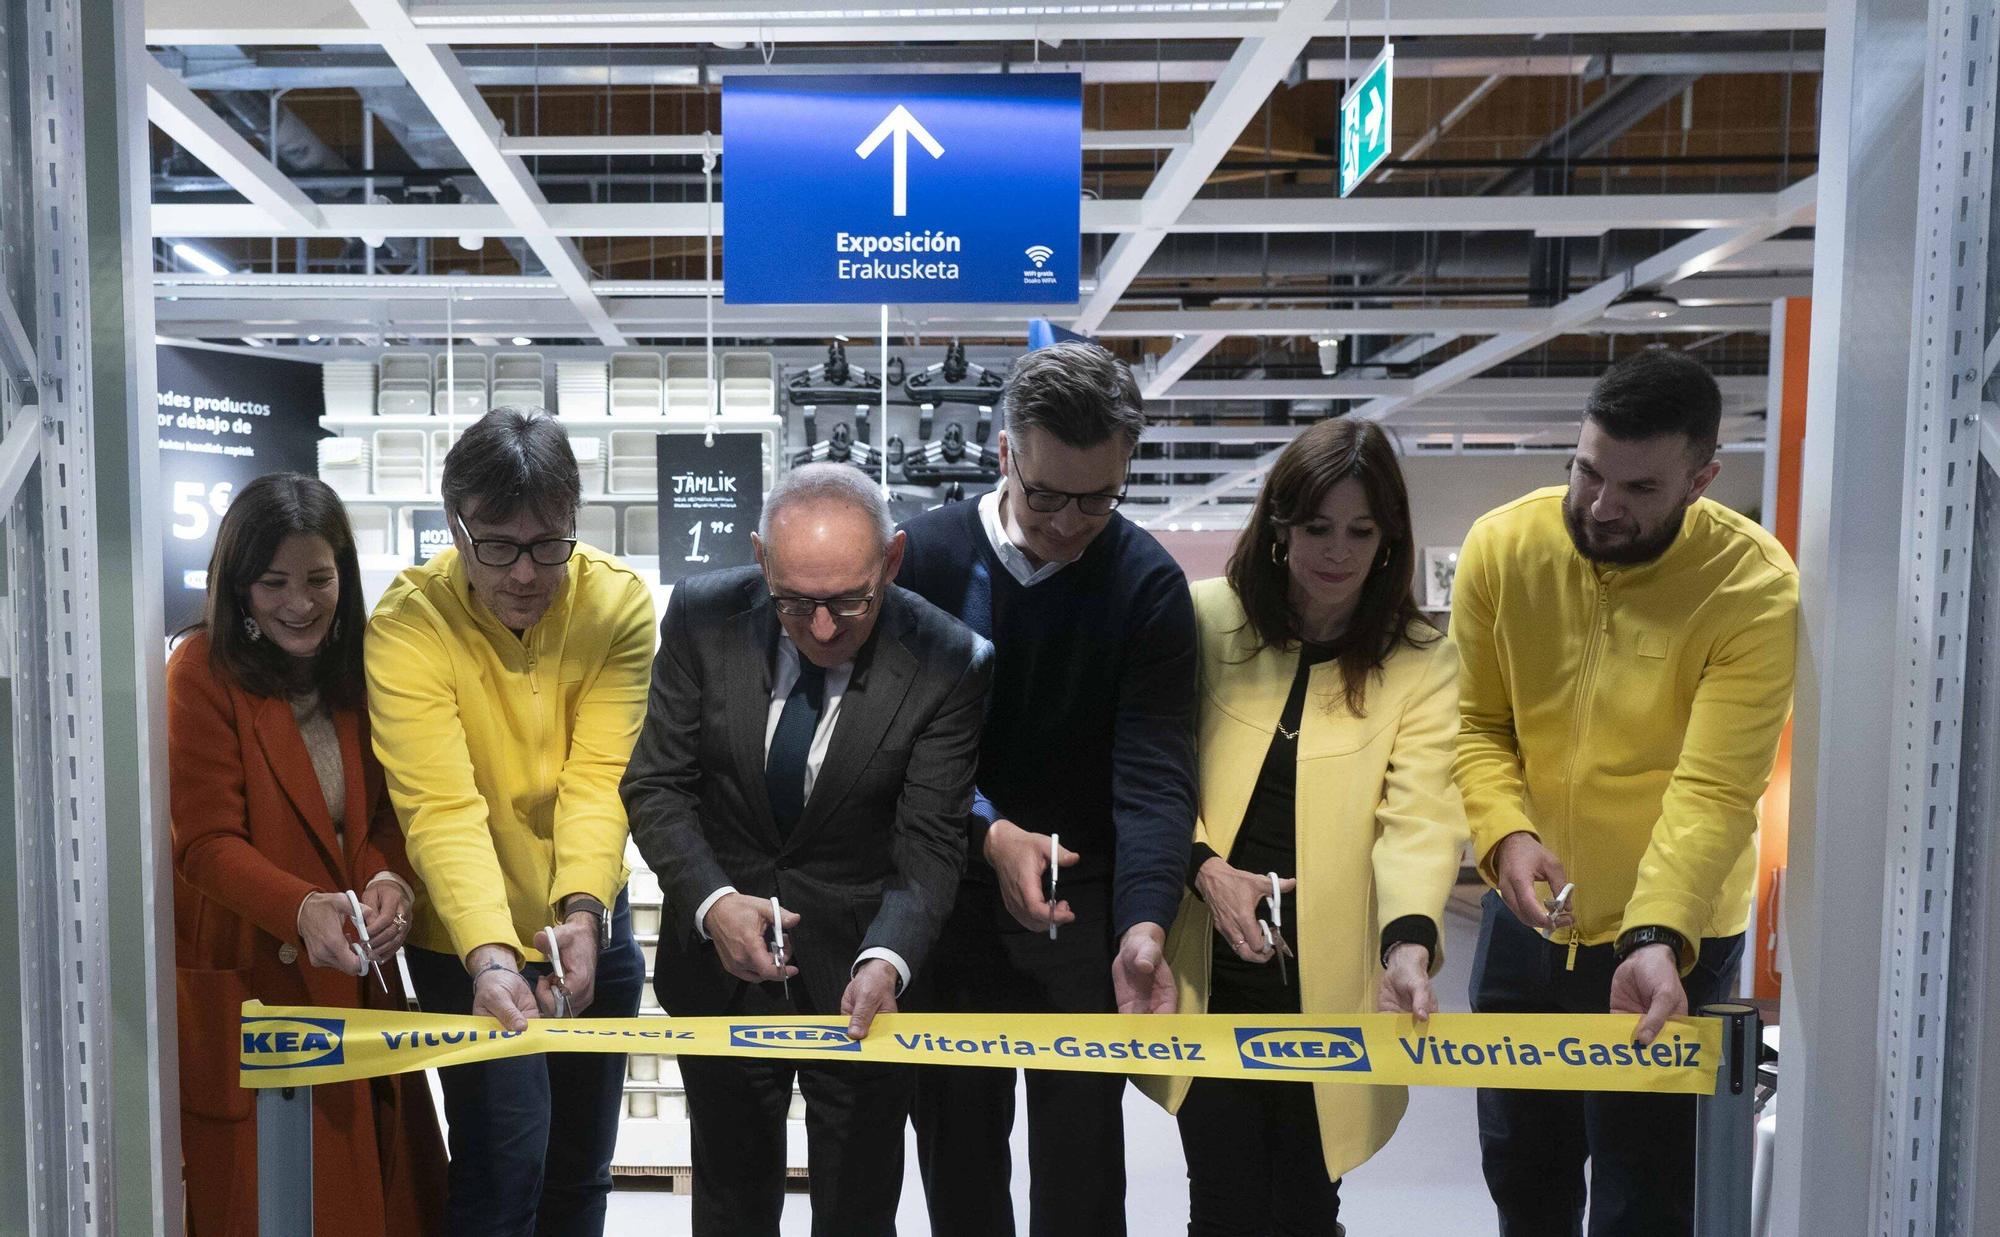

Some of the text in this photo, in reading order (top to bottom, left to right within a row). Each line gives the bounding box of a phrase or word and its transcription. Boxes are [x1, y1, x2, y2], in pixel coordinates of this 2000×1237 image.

[837, 230, 961, 257] Exposición
[838, 259, 960, 279] Erakusketa
[193, 396, 271, 416] productos
[176, 412, 230, 435] debajo
[231, 417, 252, 435] de
[671, 470, 737, 494] JÄMLIK
[743, 1030, 850, 1043] IKEA
[894, 1033, 1206, 1061] Vitoria-Gasteiz
[1250, 1041, 1354, 1059] IKEA
[1399, 1034, 1701, 1068] Vitoria-Gasteiz
